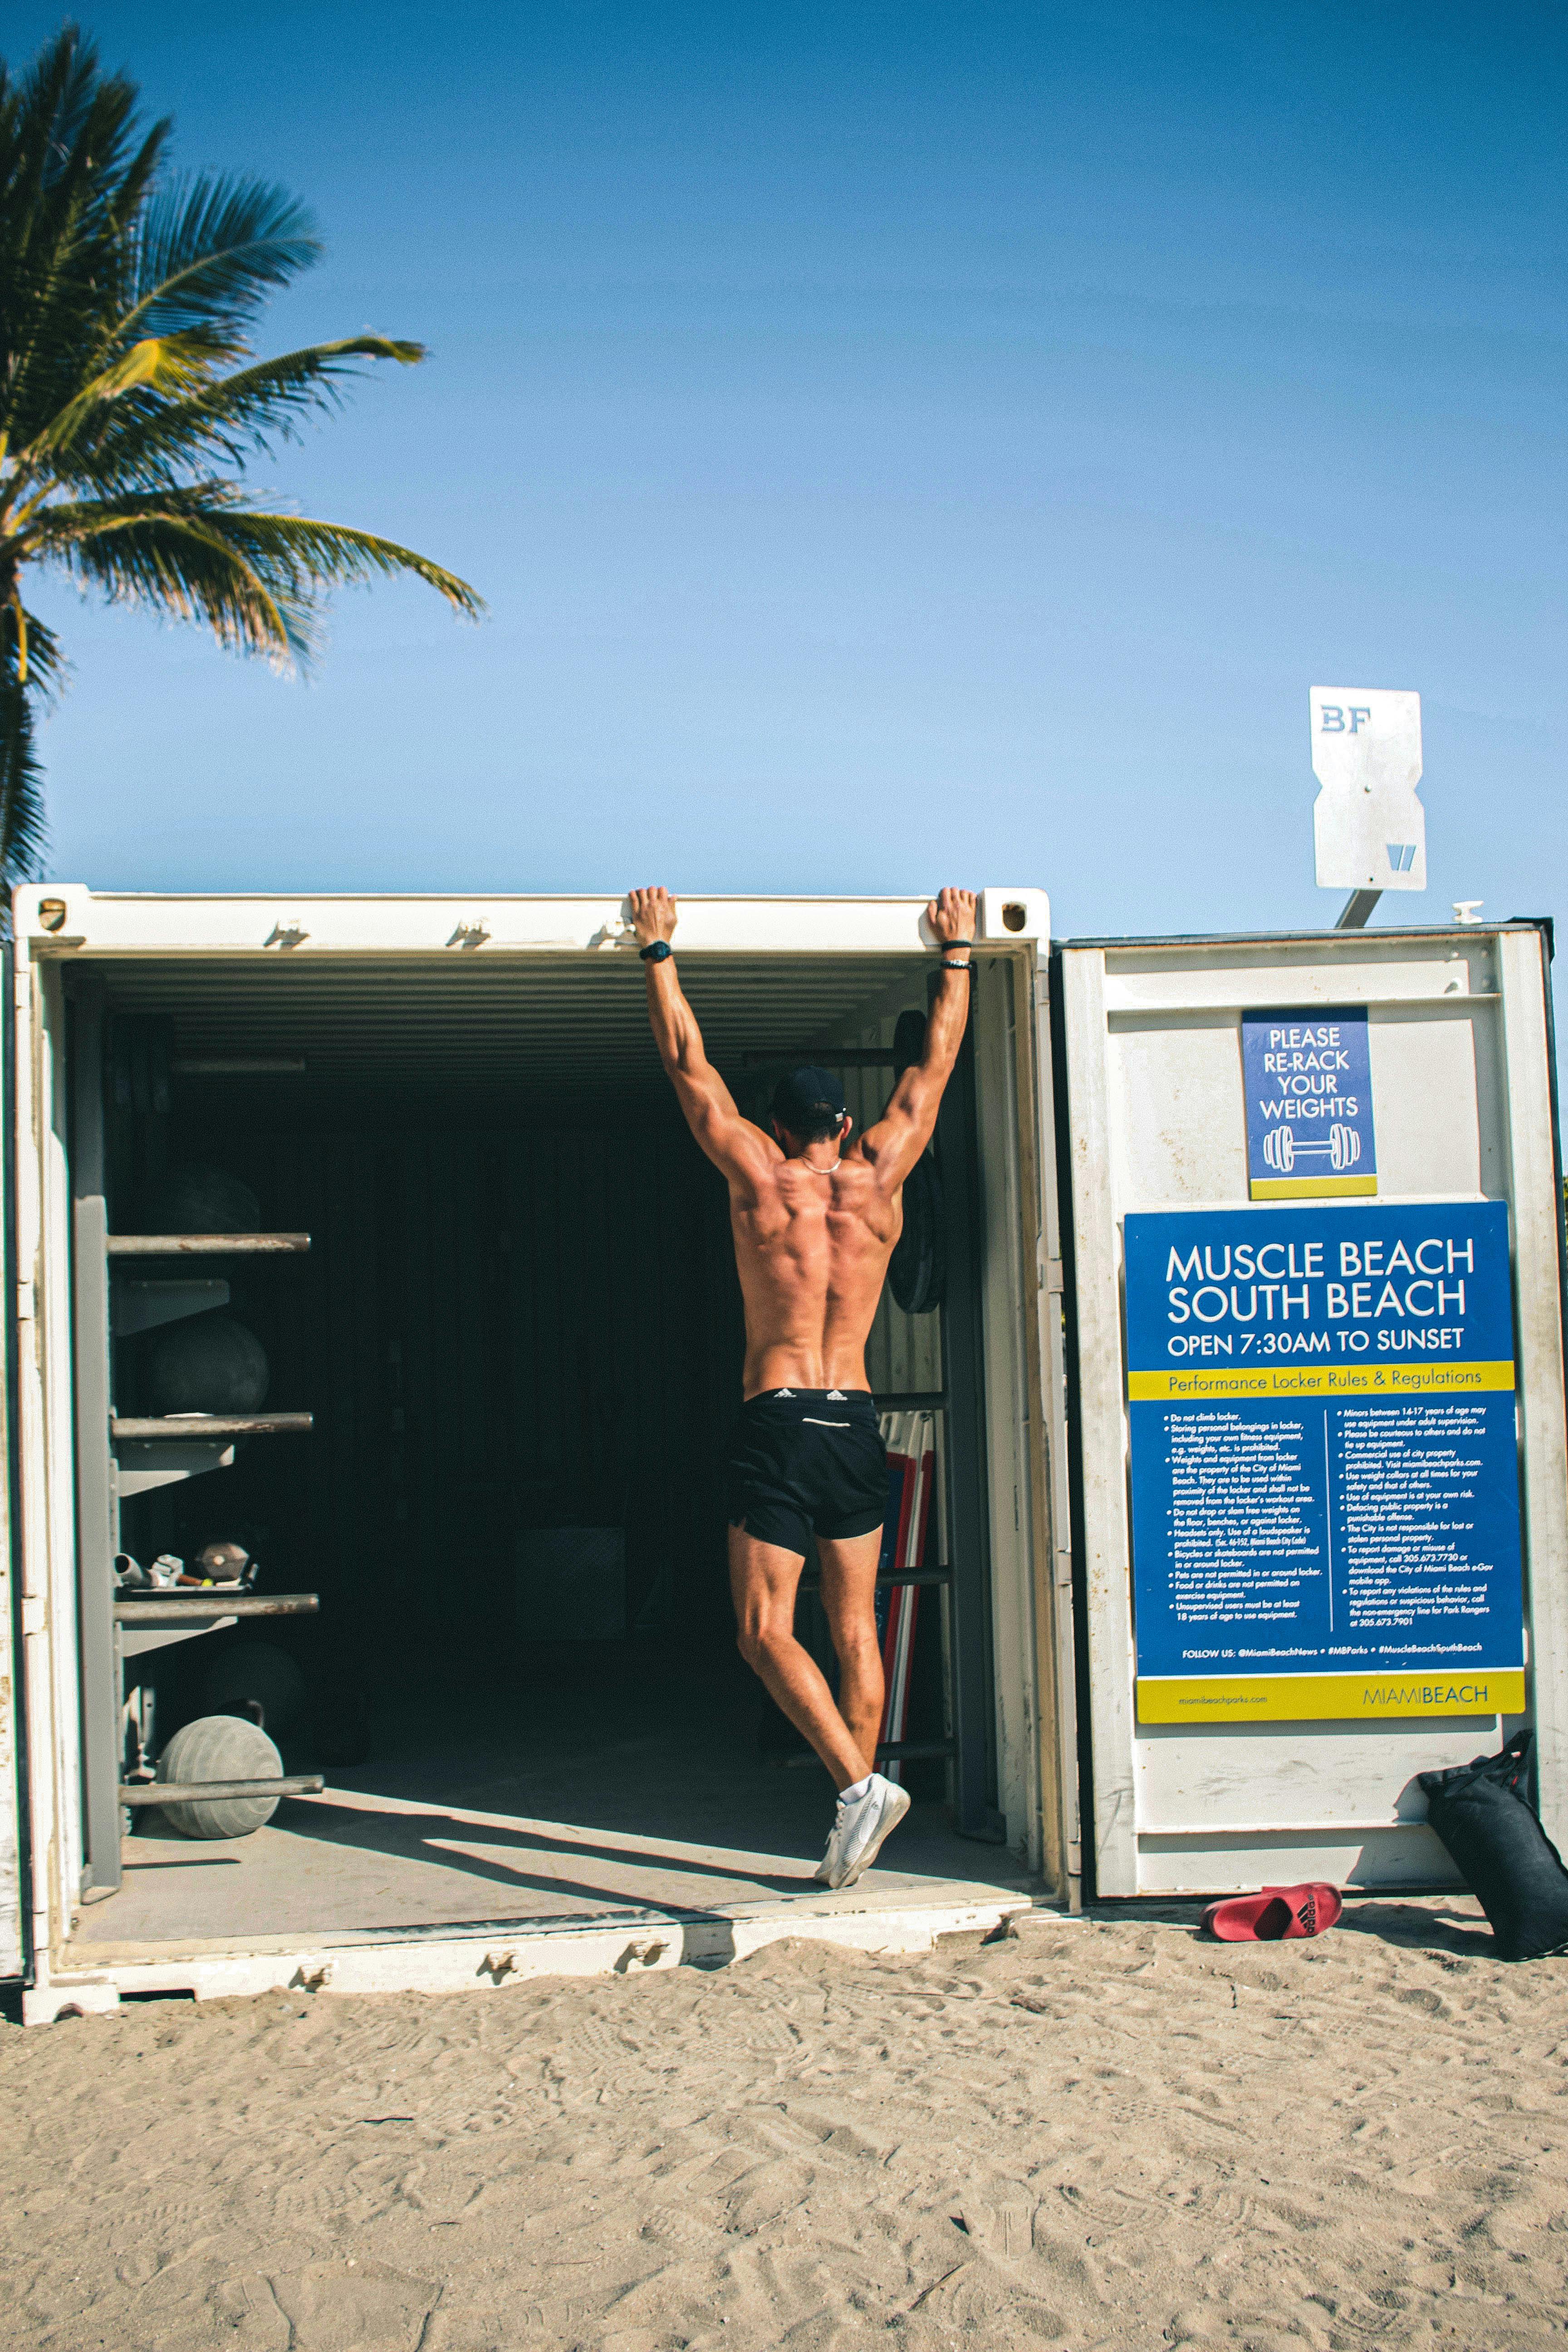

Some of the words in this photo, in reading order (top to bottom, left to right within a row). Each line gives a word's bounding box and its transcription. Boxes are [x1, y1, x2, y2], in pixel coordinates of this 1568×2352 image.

[1321, 705, 1371, 734] BF
[1270, 1027, 1340, 1049] PLEASE
[1264, 1050, 1350, 1073] RE-RACK
[1278, 1074, 1338, 1095] YOUR
[1259, 1097, 1358, 1120] WEIGHTS
[1166, 1242, 1324, 1282] MUSCLE
[1340, 1238, 1473, 1276] BEACH
[1168, 1284, 1309, 1323] SOUTH
[1327, 1279, 1465, 1318] BEACH
[1167, 1334, 1232, 1356] OPEN
[1240, 1331, 1331, 1354] 7:30AM
[1337, 1330, 1369, 1352] TO
[1377, 1328, 1465, 1351] SUNSET
[1169, 1375, 1267, 1391] Performance
[1273, 1372, 1322, 1389] Locker
[1328, 1370, 1368, 1387] Rules
[1373, 1370, 1385, 1384] &
[1392, 1368, 1482, 1388] Regulations
[1446, 1406, 1454, 1414] of
[1196, 1413, 1216, 1421] climb
[1357, 1420, 1395, 1428] equipment
[1396, 1418, 1416, 1426] under
[1418, 1417, 1436, 1425] adult
[1171, 1425, 1197, 1434] Storing
[1197, 1423, 1229, 1433] personal
[1230, 1423, 1270, 1432] belongings
[1171, 1433, 1204, 1444] including
[1240, 1432, 1263, 1441] fitness
[1171, 1455, 1202, 1465] Weights
[1203, 1455, 1218, 1463] and
[1219, 1455, 1257, 1464] equipment
[1257, 1453, 1274, 1461] from
[1275, 1453, 1298, 1461] locker
[1345, 1450, 1387, 1459] Commercial
[1402, 1449, 1411, 1457] of
[1411, 1450, 1425, 1458] city
[1426, 1450, 1456, 1458] property
[1186, 1465, 1198, 1474] the
[1198, 1466, 1230, 1475] property
[1230, 1464, 1239, 1472] of
[1252, 1464, 1268, 1473] City
[1268, 1463, 1277, 1471] of
[1198, 1508, 1217, 1517] drop
[1245, 1506, 1260, 1514] free
[1261, 1505, 1289, 1515] weights
[1250, 1517, 1277, 1526] against
[1347, 1513, 1386, 1523] punishable
[1369, 1534, 1401, 1544] personal
[1358, 1546, 1381, 1554] report
[1381, 1545, 1411, 1554] damage
[1447, 1542, 1455, 1550] of
[1193, 1559, 1220, 1568] around
[1348, 1566, 1385, 1574] download
[1398, 1565, 1413, 1574] City
[1414, 1564, 1423, 1573] of
[1448, 1563, 1470, 1572] Beach
[1217, 1569, 1252, 1579] permitted
[1271, 1568, 1298, 1576] around
[1349, 1577, 1373, 1585] mobile
[1176, 1601, 1224, 1612] Unsupervised
[1443, 1606, 1460, 1614] Park
[1460, 1606, 1490, 1615] Rangers
[1209, 1612, 1218, 1620] of
[1359, 1617, 1413, 1626] 305.673.7901
[1182, 1649, 1220, 1658] FOLLOW
[1221, 1649, 1236, 1658] US:
[1238, 1647, 1318, 1657] @MiamiBeachNews
[1328, 1645, 1368, 1655] #MBParks
[1378, 1642, 1483, 1654] #MuscleBeachSouthBeach
[1179, 1694, 1267, 1705] miamibeachparks.com
[1362, 1685, 1488, 1705] MIAMIBEACH
